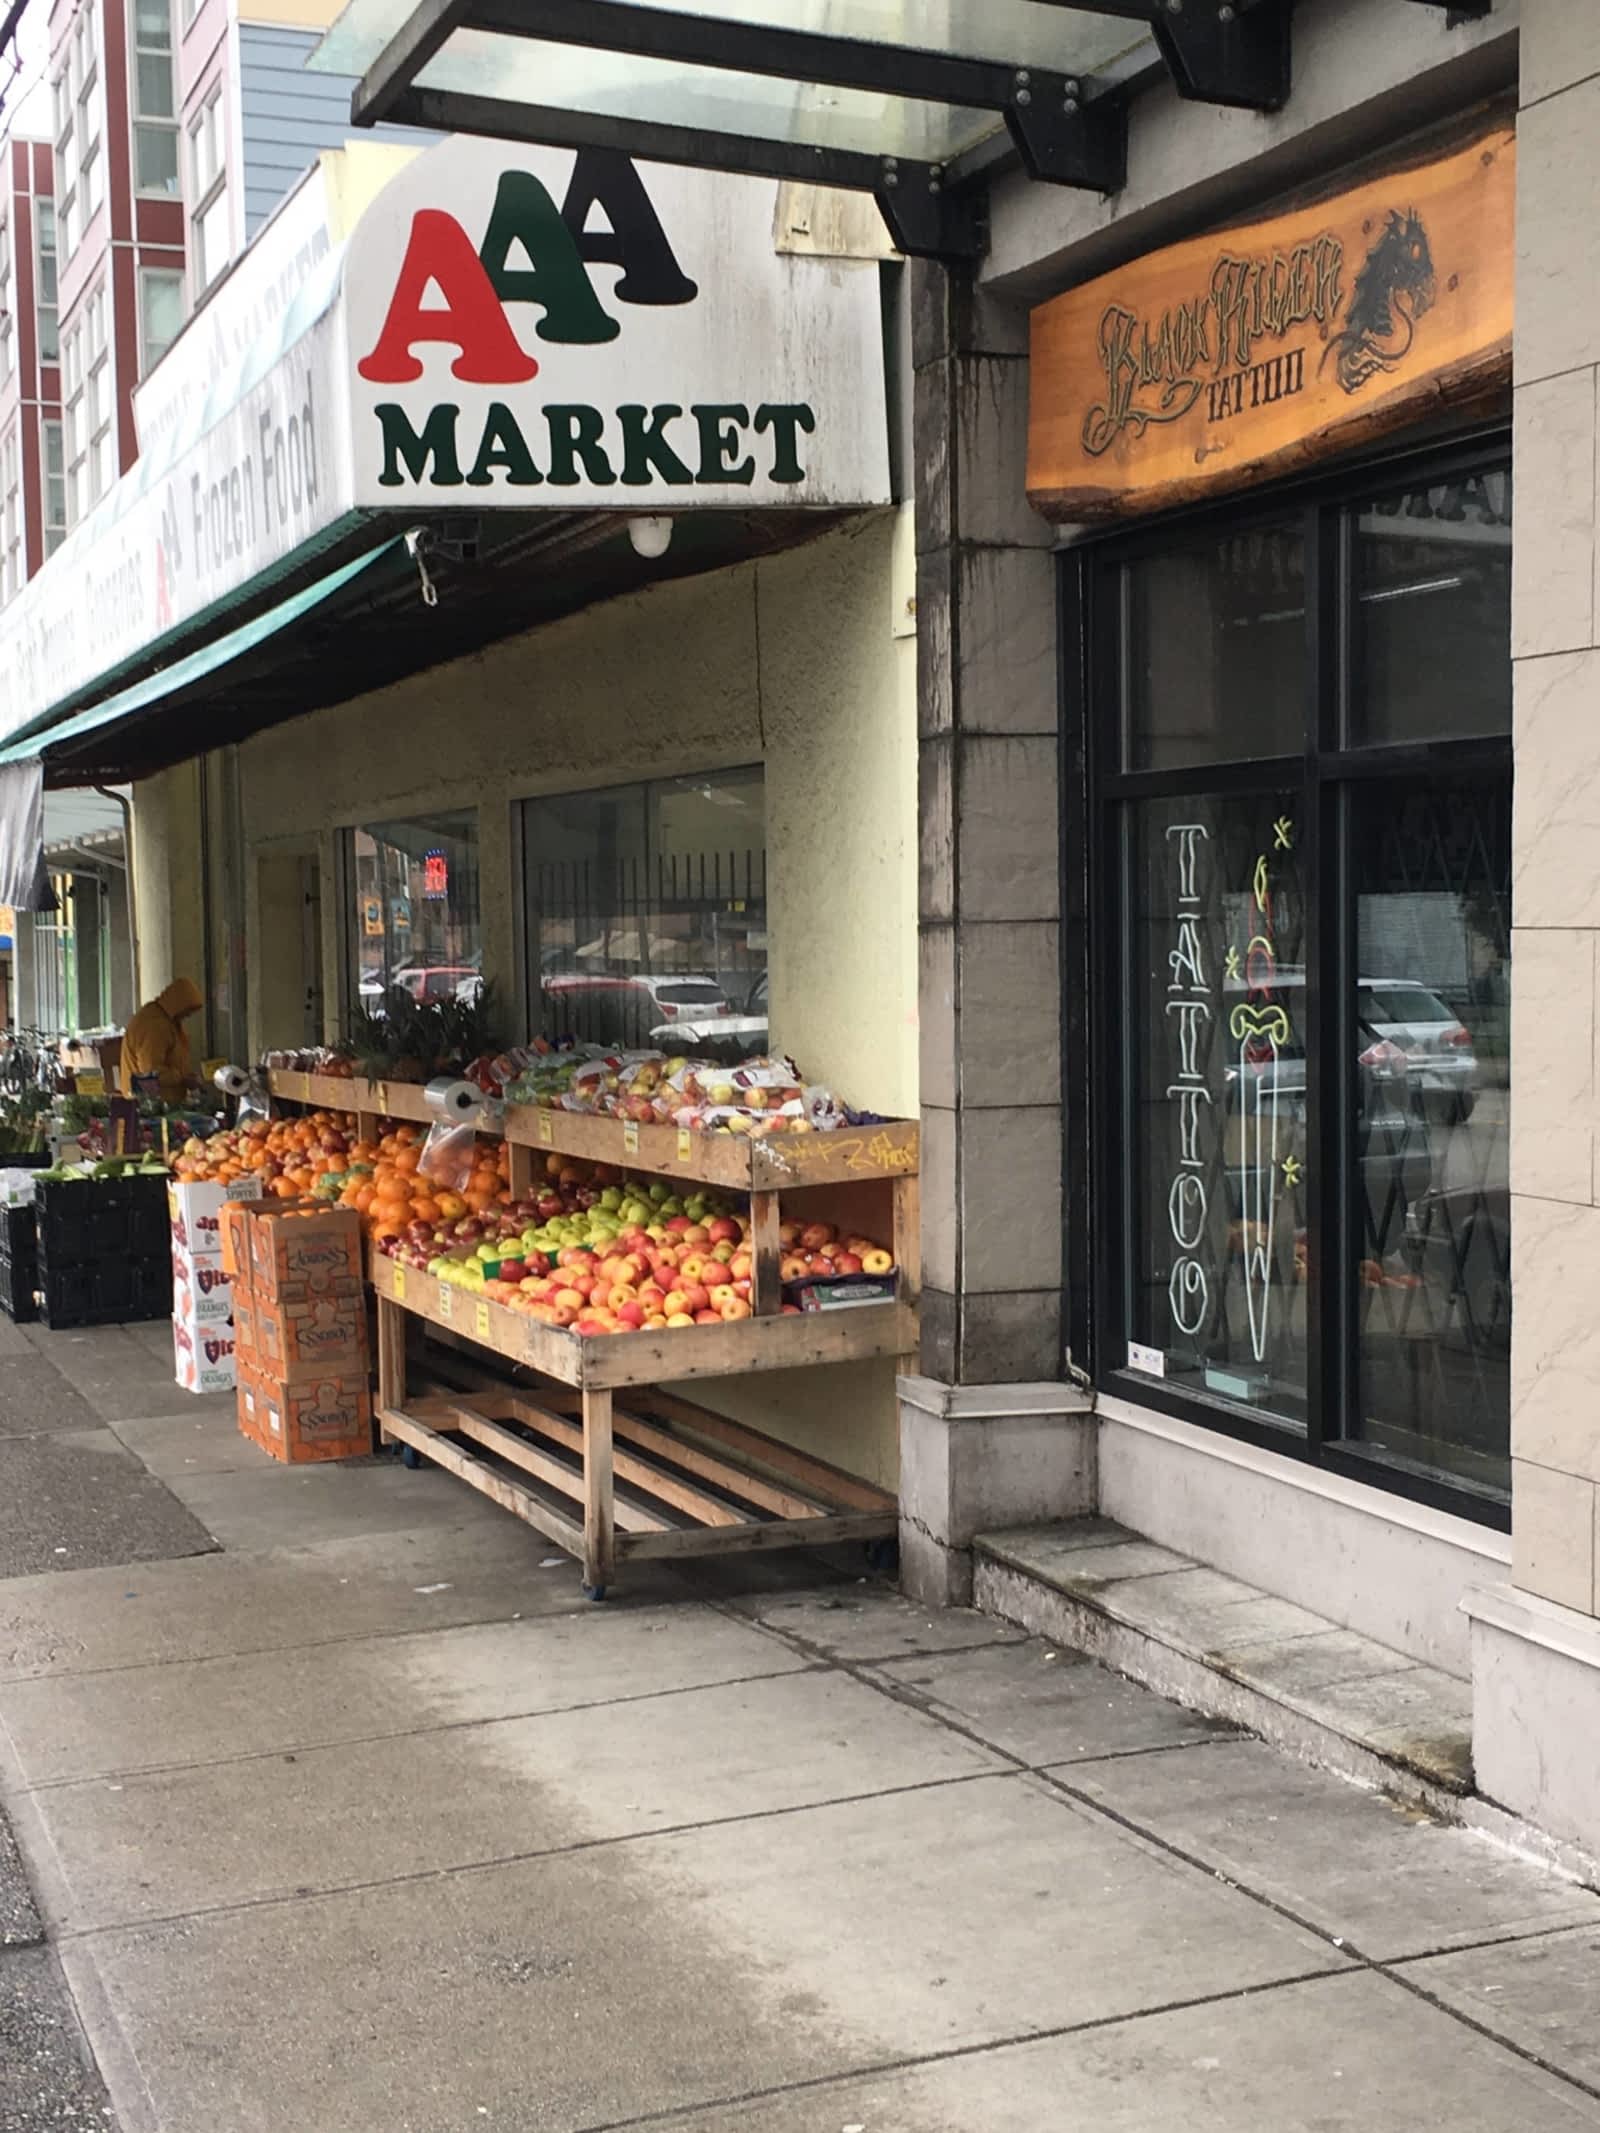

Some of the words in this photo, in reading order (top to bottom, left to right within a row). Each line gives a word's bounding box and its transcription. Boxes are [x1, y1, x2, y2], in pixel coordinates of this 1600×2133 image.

[357, 147, 698, 385] AAA
[189, 452, 258, 582] Frozen
[259, 367, 320, 534] Food
[374, 402, 815, 487] MARKET
[1206, 348, 1305, 424] TATTOO
[1165, 824, 1212, 1335] TATTOO
